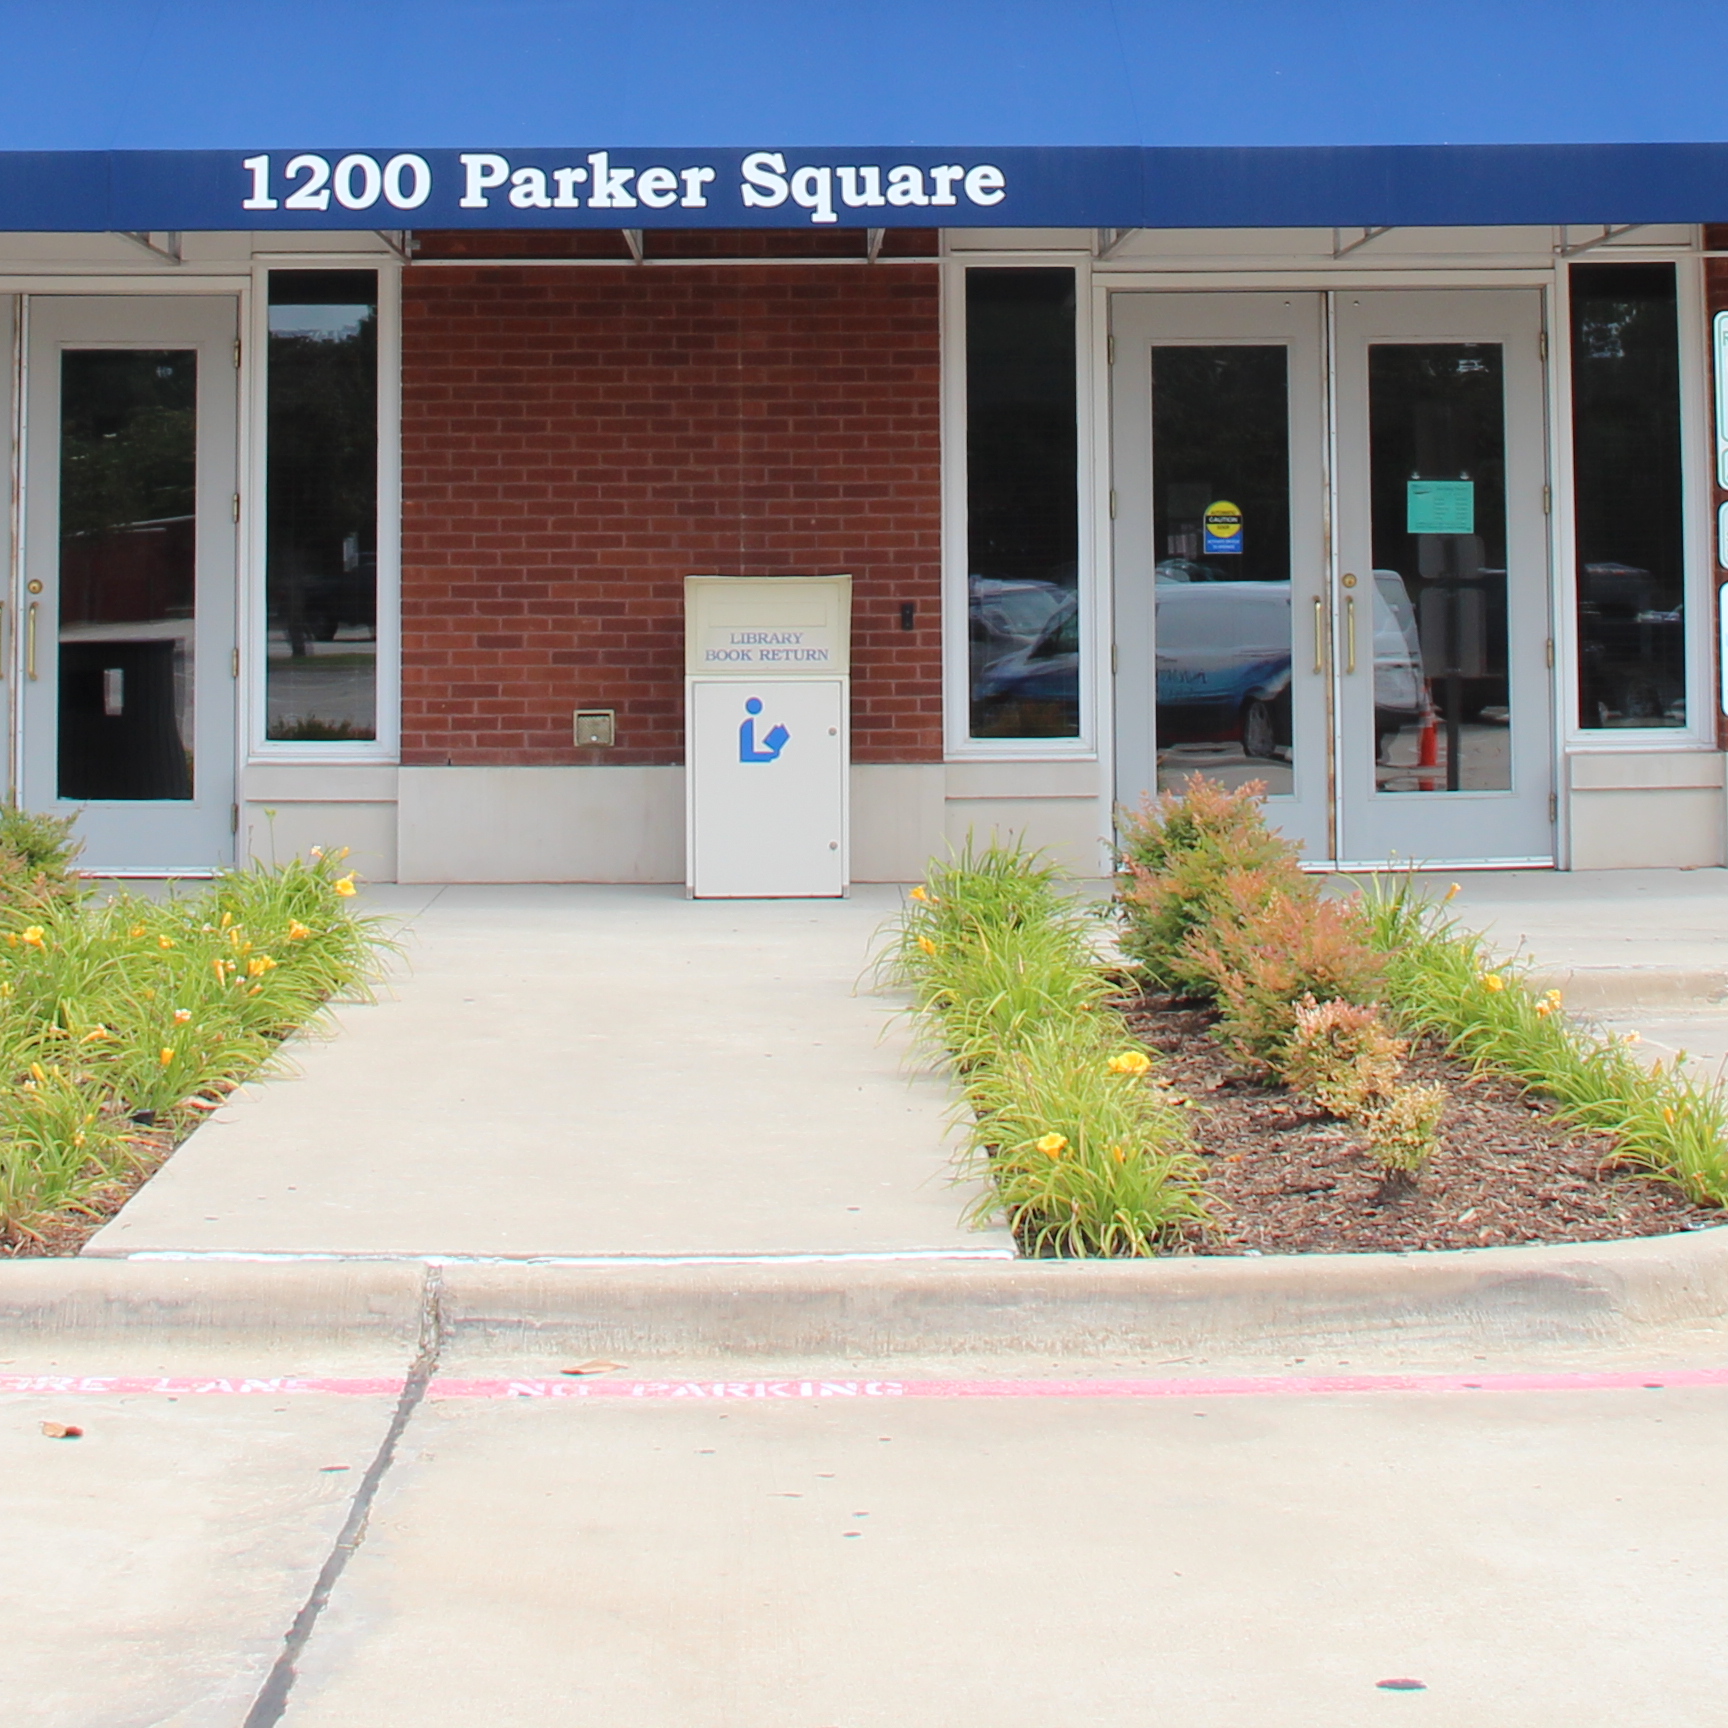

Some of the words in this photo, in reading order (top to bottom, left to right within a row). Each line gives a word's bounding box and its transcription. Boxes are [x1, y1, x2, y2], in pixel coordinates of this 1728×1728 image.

[241, 151, 433, 212] 1200
[459, 151, 715, 211] Parker
[740, 151, 1006, 223] Square
[730, 632, 805, 645] LIBRARY
[705, 649, 753, 661] BOOK
[759, 648, 829, 662] RETURN
[508, 1381, 590, 1397] NO
[632, 1381, 904, 1398] PARKING
